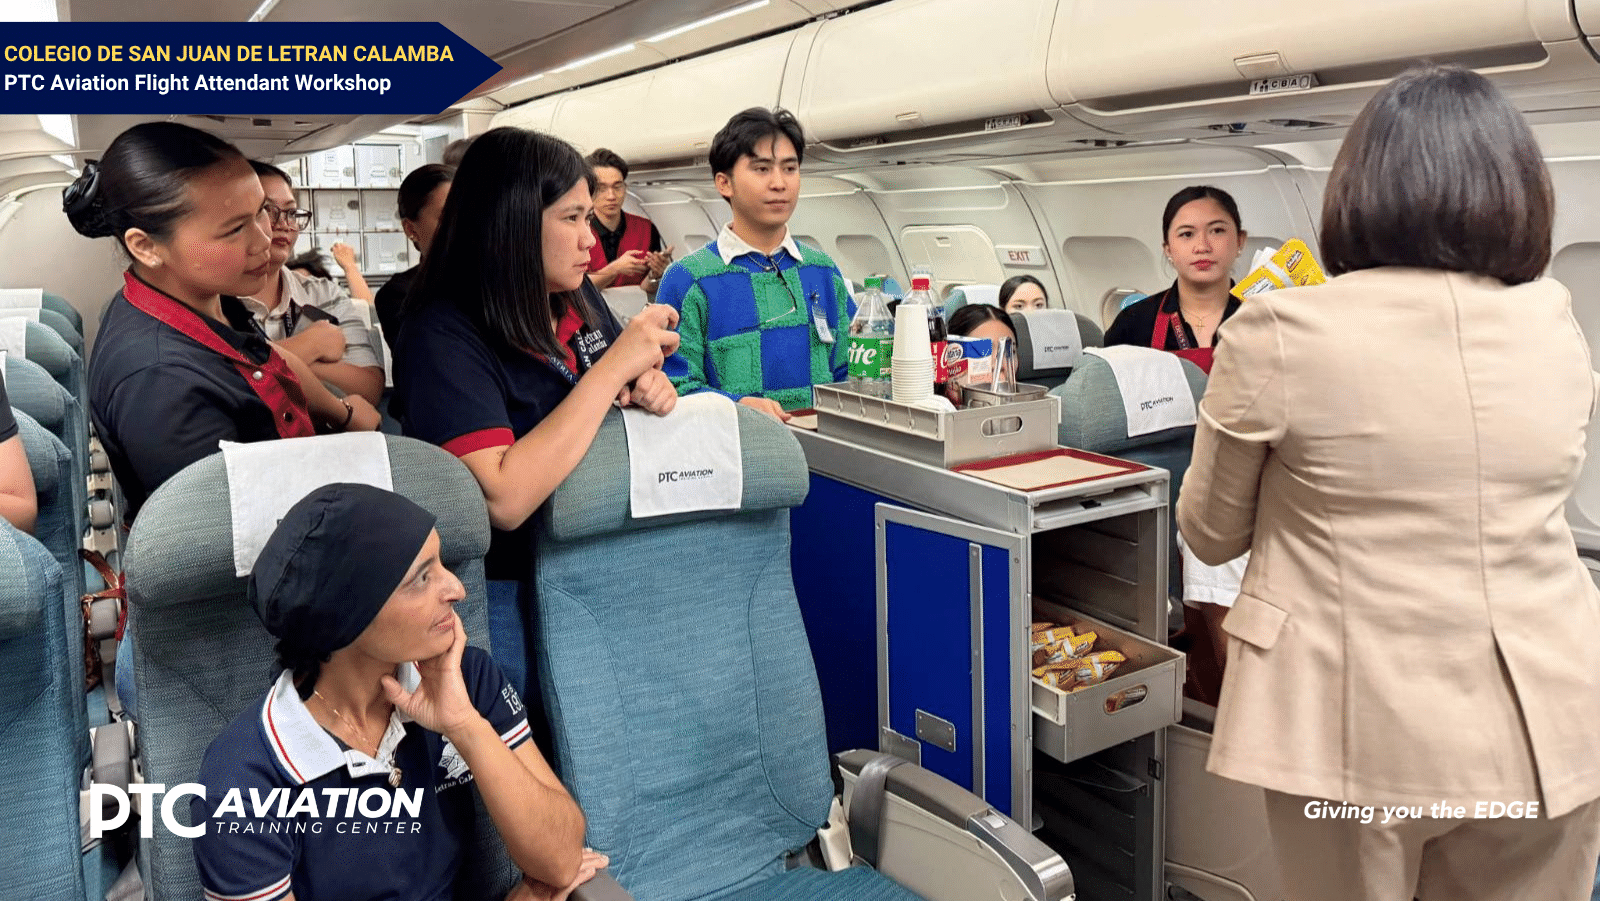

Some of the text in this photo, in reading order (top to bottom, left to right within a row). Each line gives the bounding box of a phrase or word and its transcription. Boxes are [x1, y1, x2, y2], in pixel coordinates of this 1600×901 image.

[1008, 250, 1030, 262] EXIT
[584, 329, 603, 345] etran
[848, 341, 877, 366] ite
[658, 471, 678, 484] PTC
[679, 468, 714, 478] AVIATION
